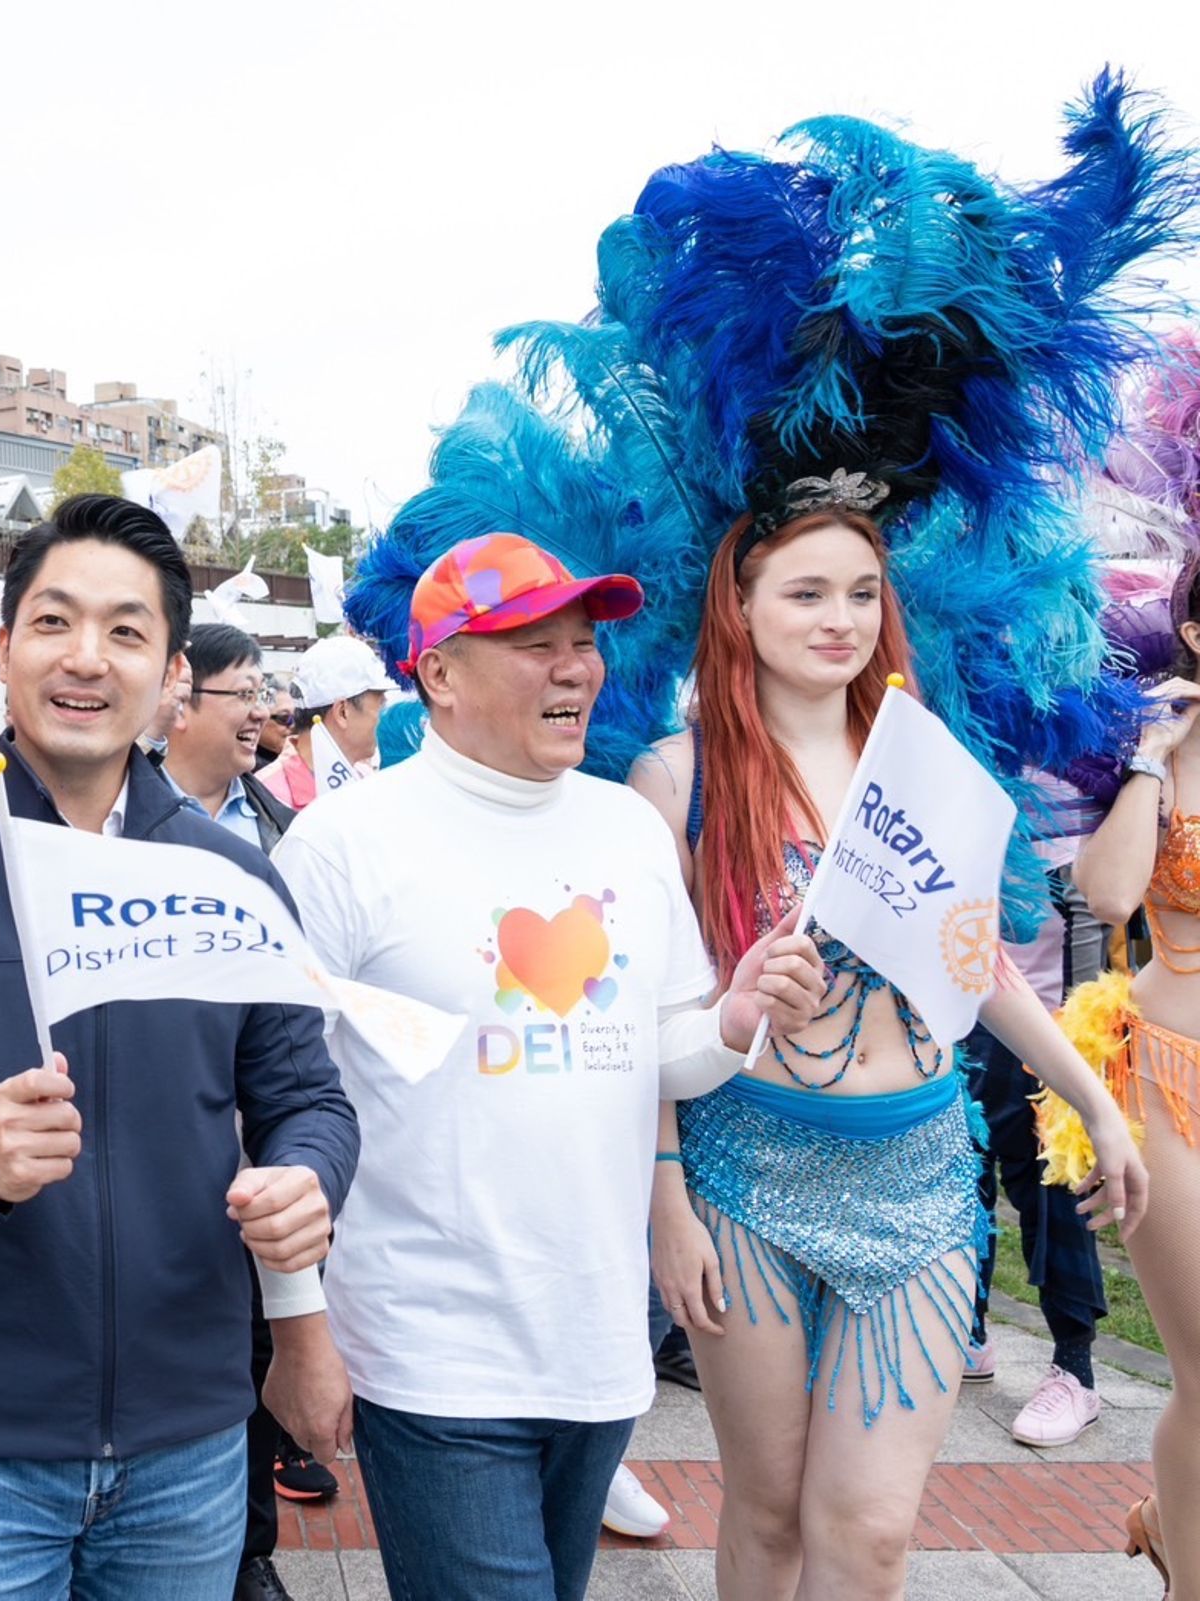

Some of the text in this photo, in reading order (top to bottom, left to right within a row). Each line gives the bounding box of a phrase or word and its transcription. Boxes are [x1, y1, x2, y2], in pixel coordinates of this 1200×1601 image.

[855, 781, 956, 894] Rotary
[833, 838, 918, 919] istrict 3522
[46, 929, 287, 976] District 352
[477, 1023, 572, 1075] DEI
